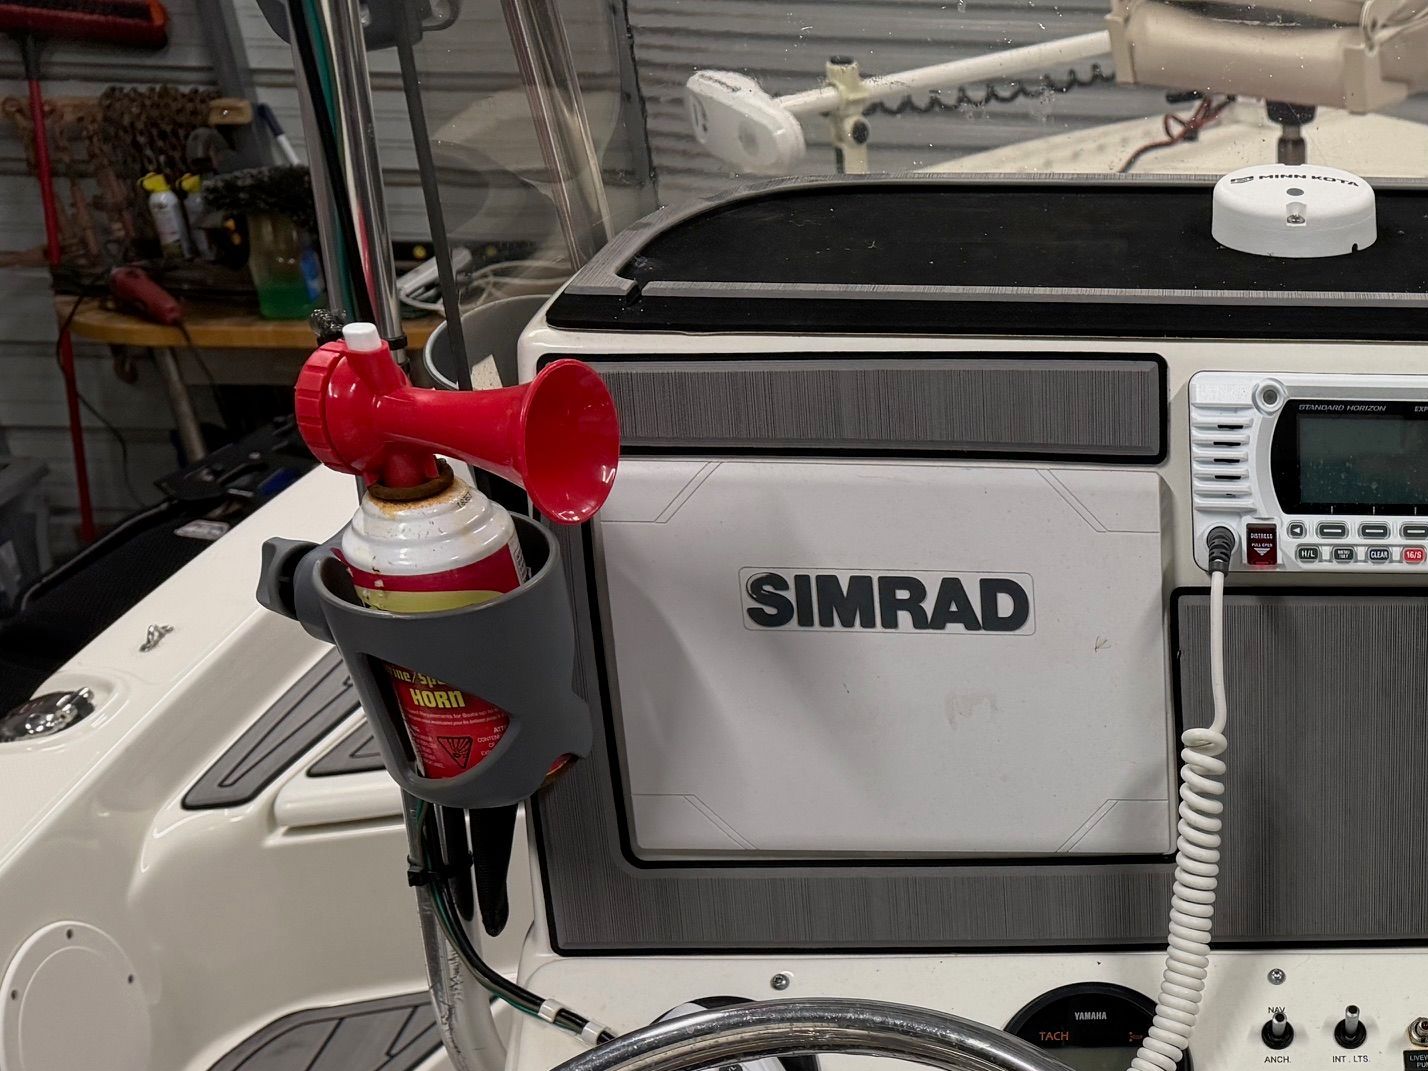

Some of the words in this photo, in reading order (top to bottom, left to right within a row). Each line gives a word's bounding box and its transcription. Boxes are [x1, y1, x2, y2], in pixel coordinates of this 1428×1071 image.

[1311, 175, 1360, 187] KOTA
[1298, 404, 1345, 412] STANDARD
[1346, 404, 1387, 412] HORIZON
[1301, 550, 1315, 558] H/L
[1370, 551, 1389, 559] CLEAR
[1405, 550, 1422, 559] 16/S
[746, 572, 1030, 631] SIMRAD
[409, 688, 466, 708] HORN
[1268, 1006, 1286, 1014] NAV
[1074, 1011, 1107, 1021] YAMAHA
[1039, 1031, 1069, 1041] TACH
[1264, 1056, 1292, 1064] ANCH.
